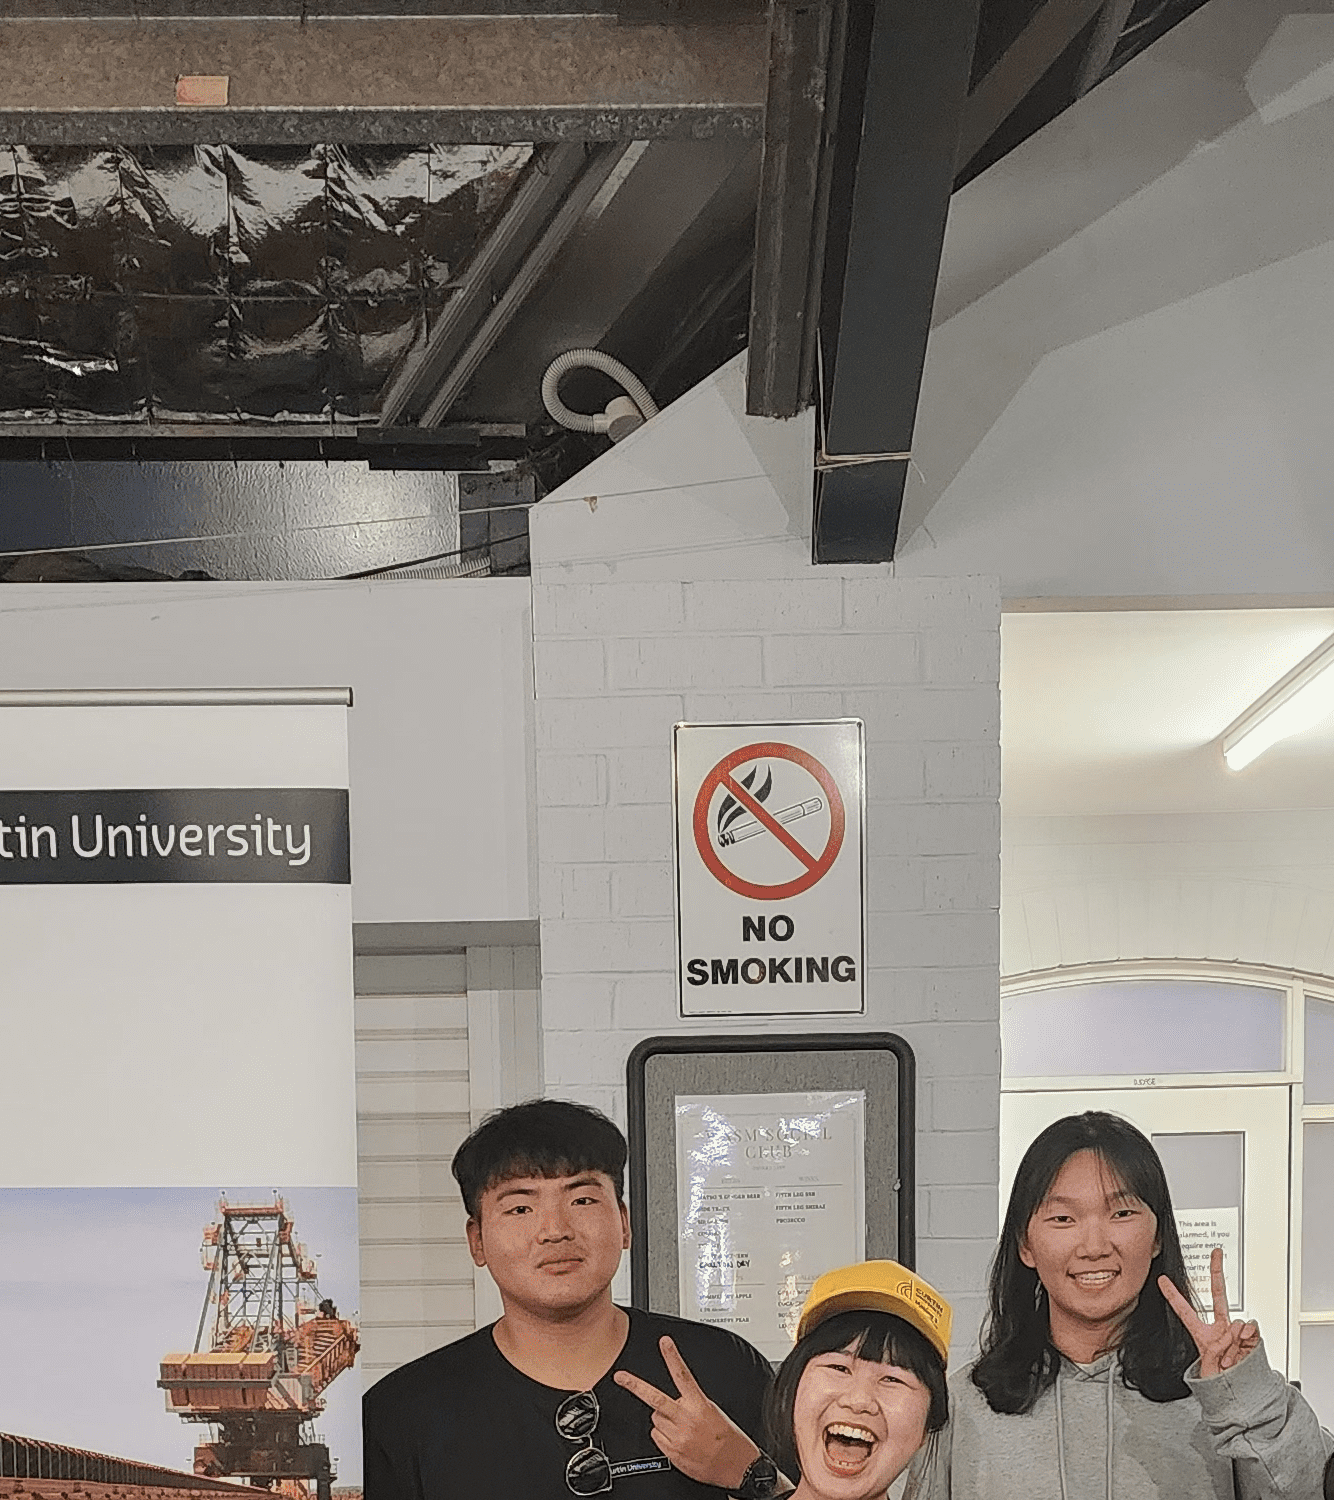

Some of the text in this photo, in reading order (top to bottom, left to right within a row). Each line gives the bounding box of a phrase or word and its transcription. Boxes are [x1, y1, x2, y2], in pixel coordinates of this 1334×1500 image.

[70, 812, 313, 866] University
[742, 914, 795, 942] NO
[686, 955, 856, 986] SMOKING
[1181, 1242, 1204, 1250] equire
[1216, 1231, 1230, 1239] you
